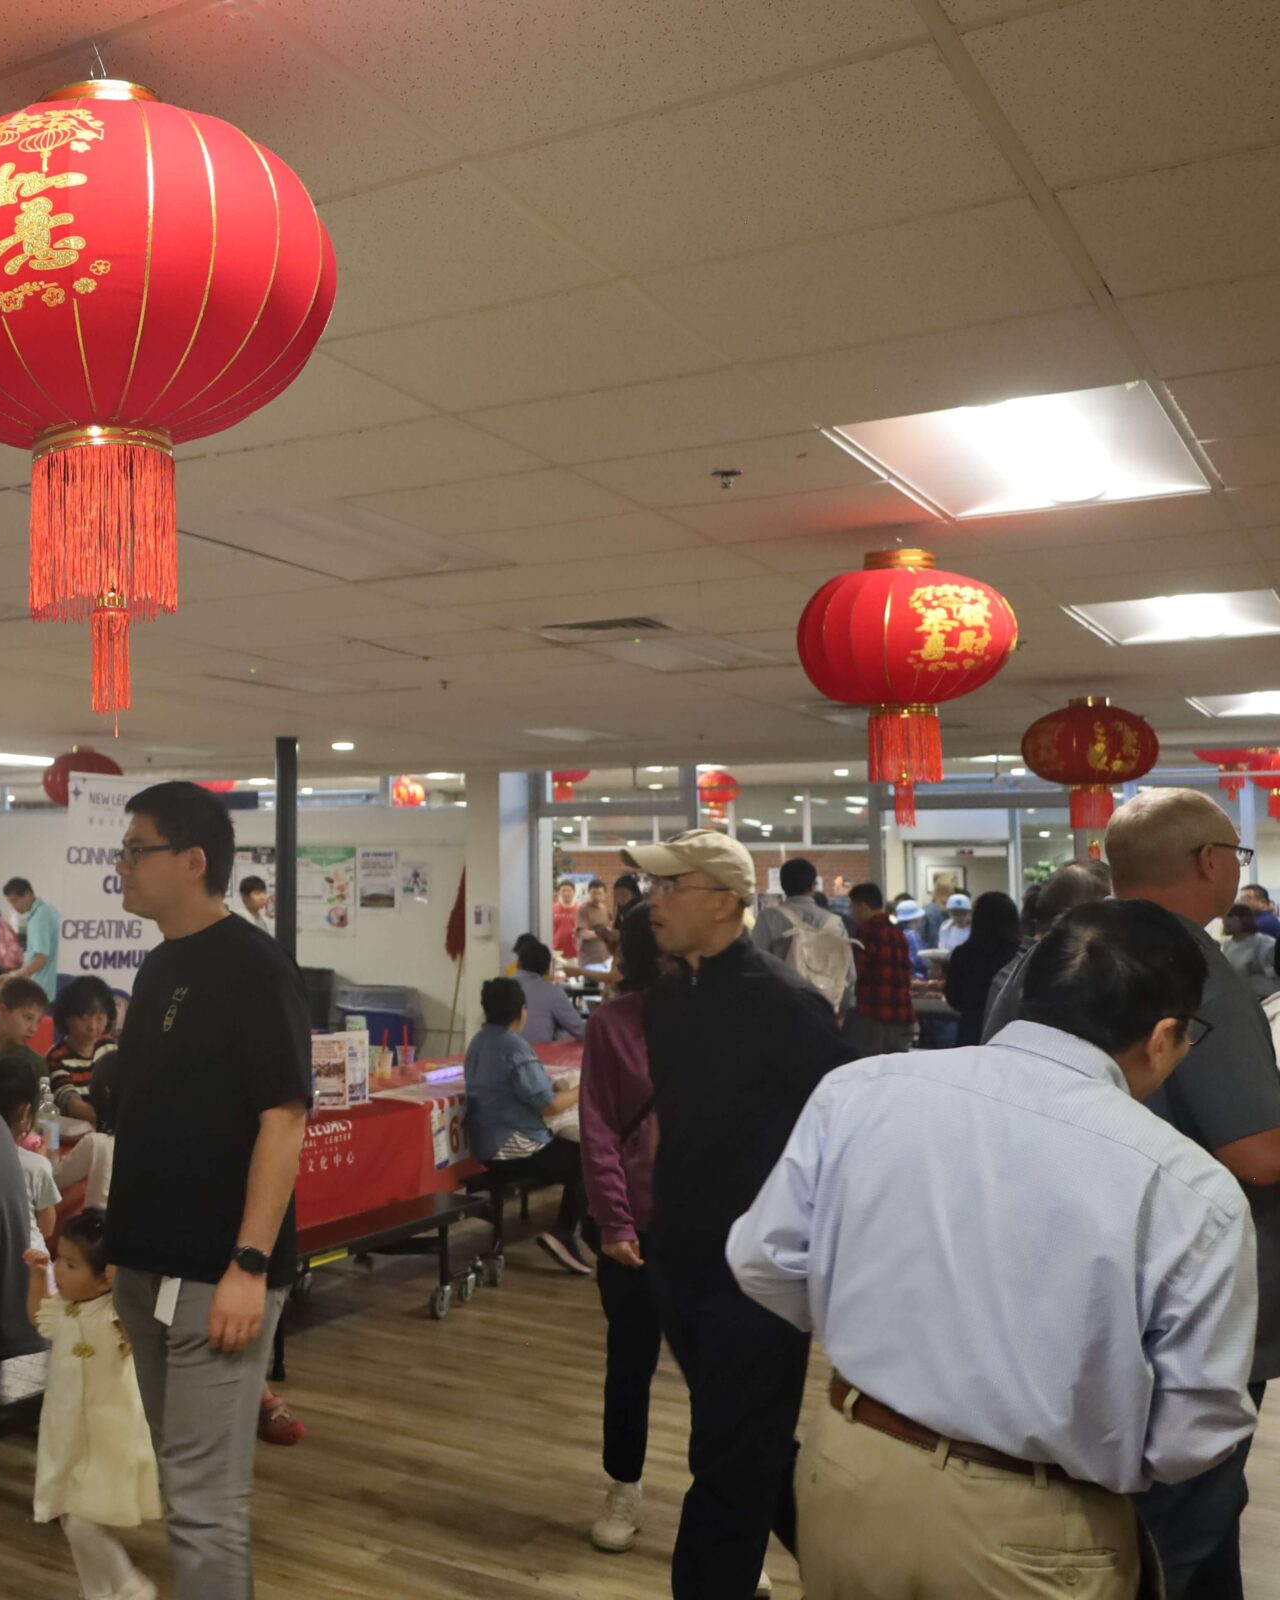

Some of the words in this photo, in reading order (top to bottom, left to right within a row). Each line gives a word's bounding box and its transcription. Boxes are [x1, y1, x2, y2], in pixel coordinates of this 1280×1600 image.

[89, 791, 110, 805] NEW
[62, 919, 142, 940] CREATING
[80, 950, 149, 970] COMMU
[324, 1132, 352, 1145] CENTER
